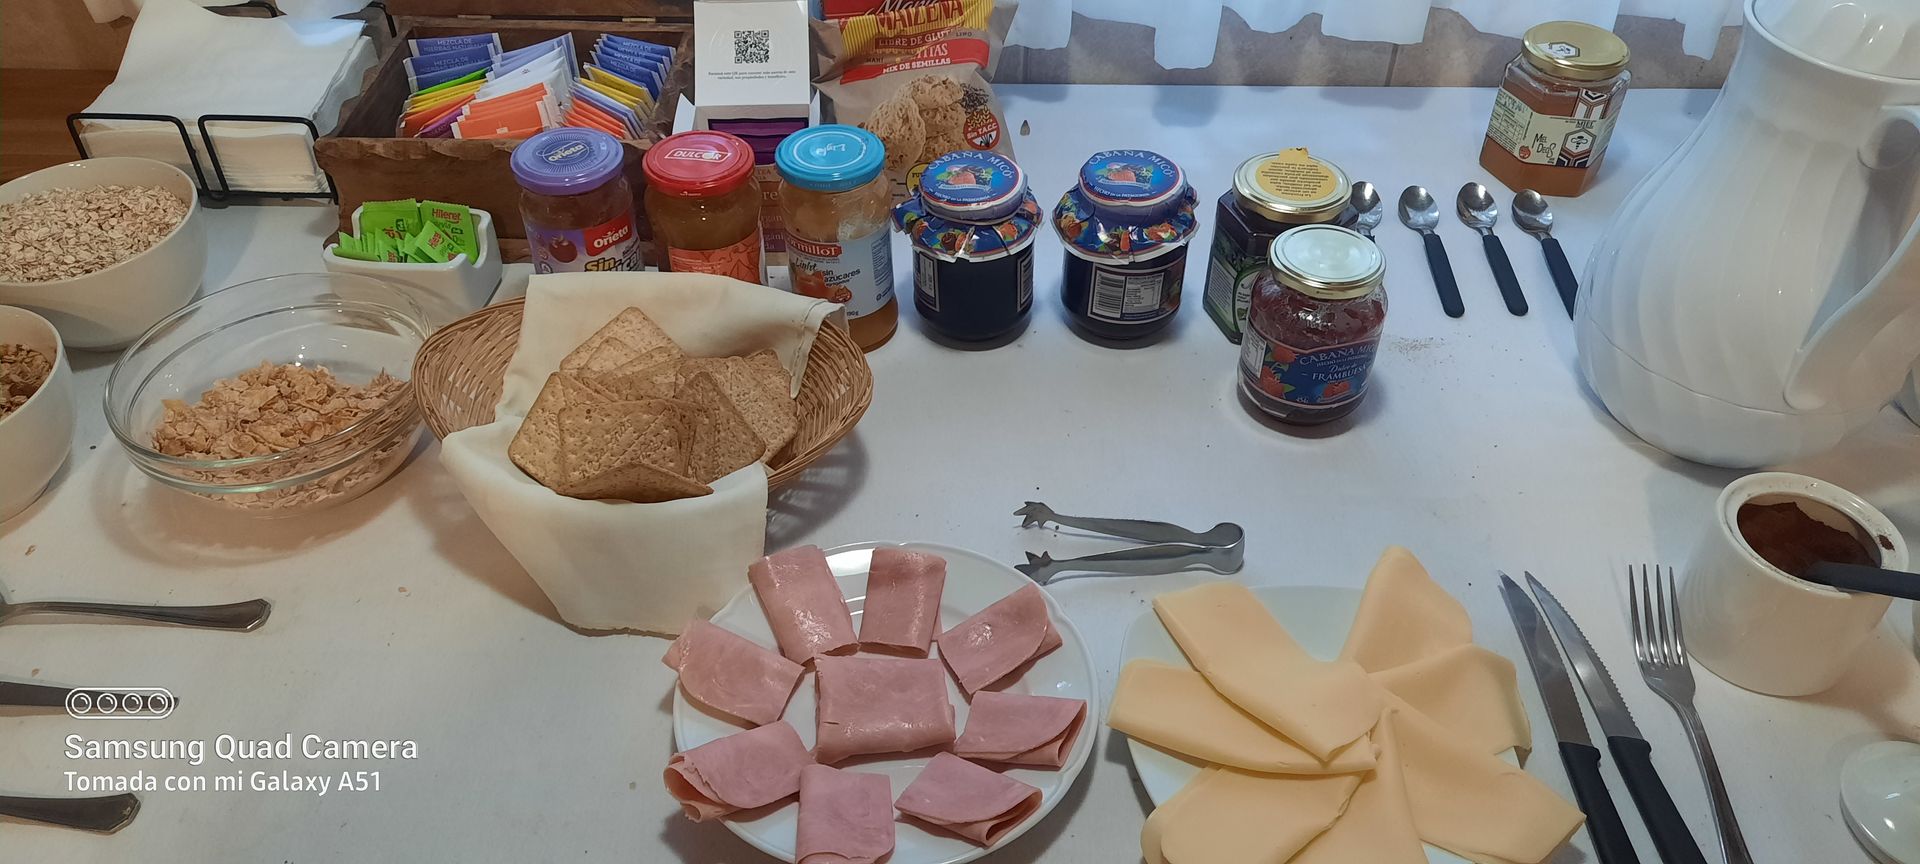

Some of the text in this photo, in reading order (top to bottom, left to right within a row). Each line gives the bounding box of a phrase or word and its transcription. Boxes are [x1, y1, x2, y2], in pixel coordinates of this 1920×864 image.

[910, 36, 923, 46] DE
[883, 58, 951, 74] MIX DE SEMILLAS
[548, 144, 584, 162] Orieta
[674, 150, 722, 160] DULCOR
[594, 226, 629, 248] Orieta
